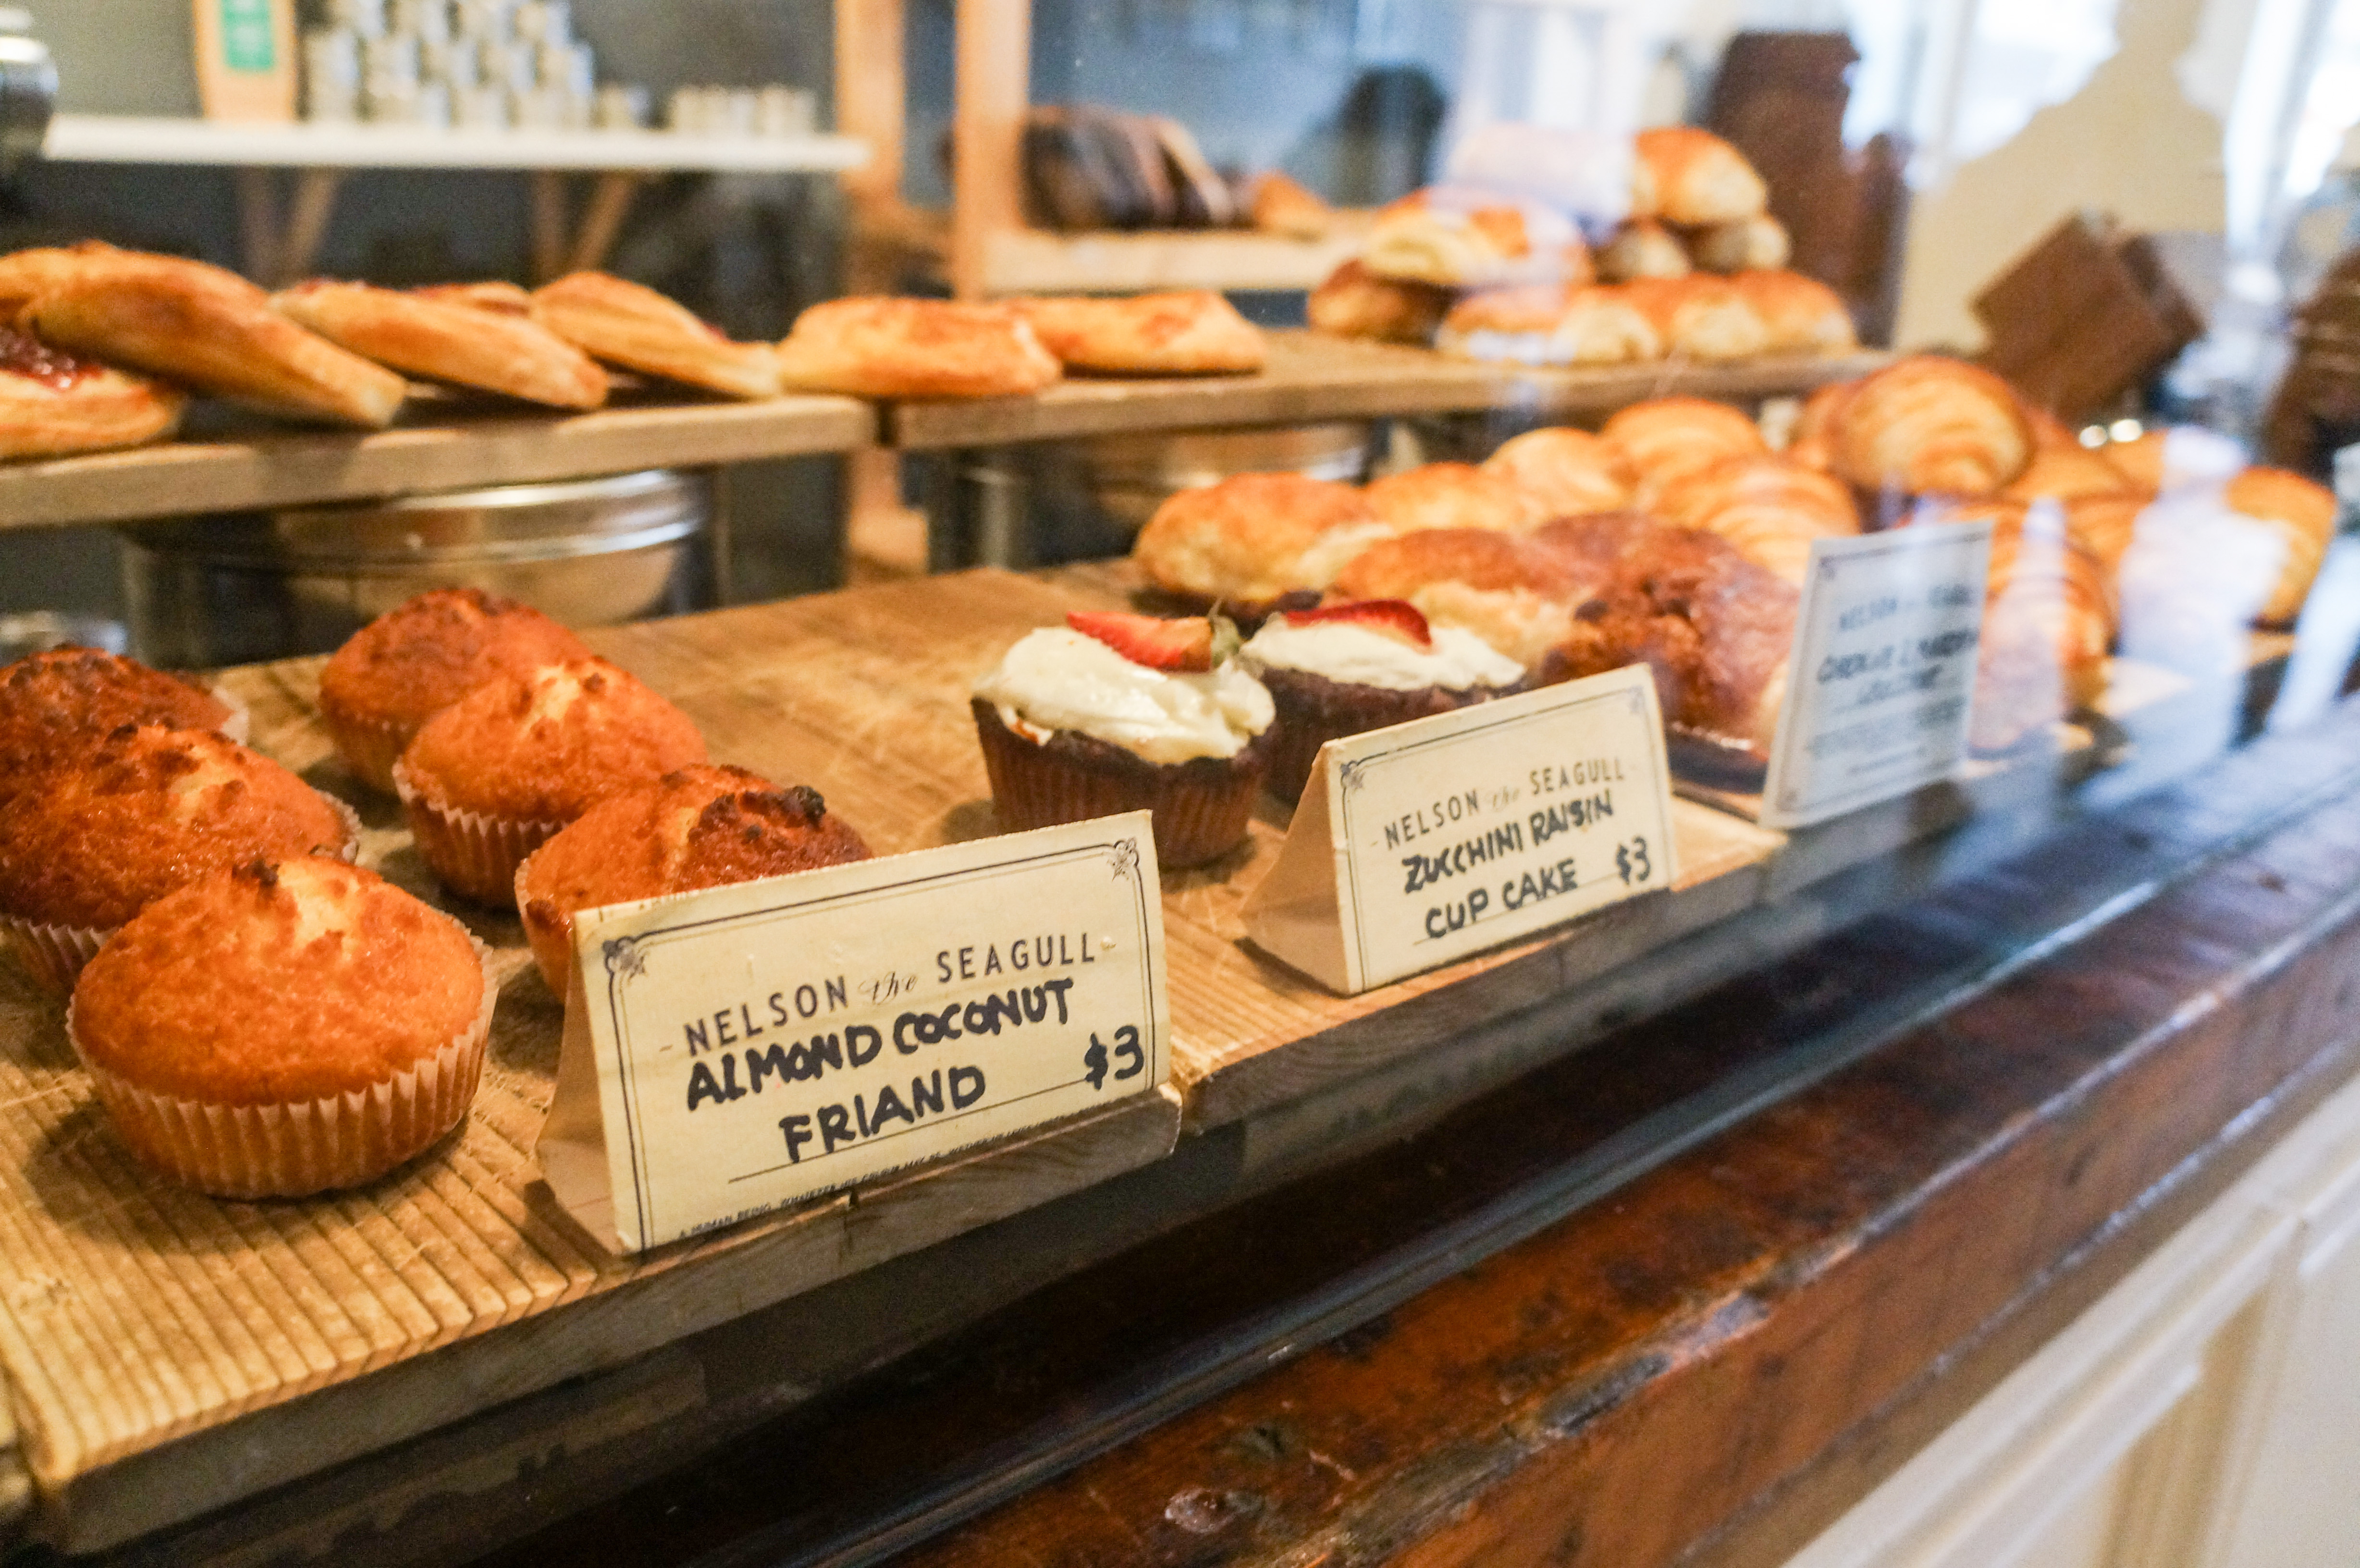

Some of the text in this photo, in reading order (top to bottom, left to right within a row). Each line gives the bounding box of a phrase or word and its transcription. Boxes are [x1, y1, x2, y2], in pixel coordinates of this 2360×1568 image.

[1384, 757, 1625, 850] NELSON the SEAGULL
[1401, 791, 1612, 894] ZUCCHINI RAISIN
[1426, 859, 1578, 939] CUP CAKE
[1616, 837, 1652, 885] $3
[684, 933, 1096, 1056] NELSON the SEAGULL
[688, 979, 1073, 1111] ALMOND COCONUT
[1083, 1026, 1144, 1089] $3
[779, 1066, 985, 1164] FRIAND
